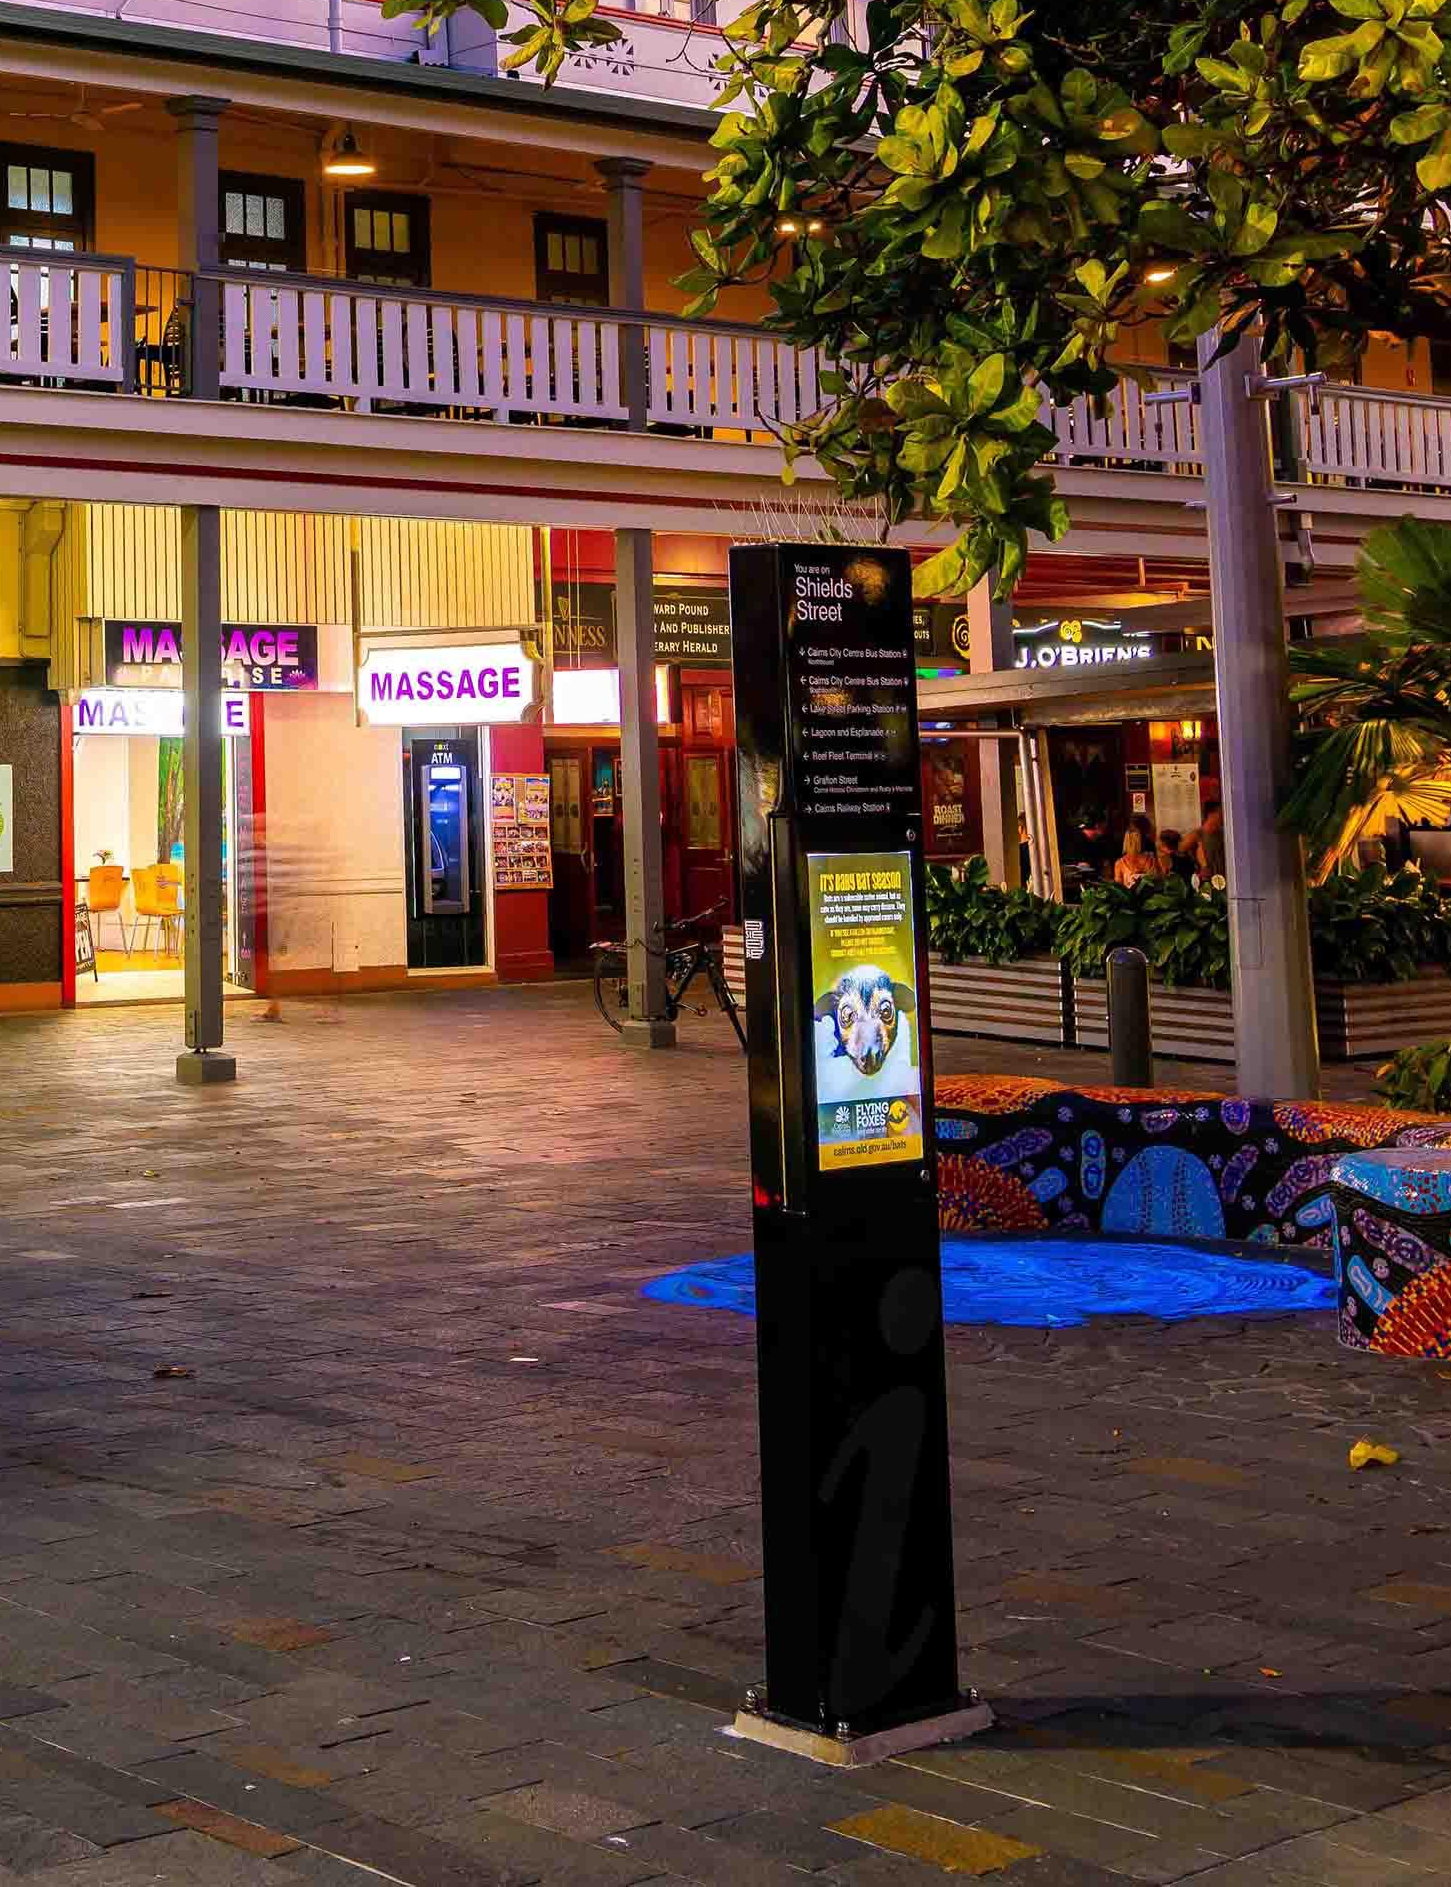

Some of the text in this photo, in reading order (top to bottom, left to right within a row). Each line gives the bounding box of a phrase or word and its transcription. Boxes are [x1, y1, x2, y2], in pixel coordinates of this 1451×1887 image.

[794, 564, 830, 574] You are on
[795, 576, 853, 599] Shields
[679, 604, 709, 616] POUND
[796, 600, 843, 622] Street
[660, 622, 678, 633] AND
[123, 626, 299, 665] MAAGE
[683, 641, 718, 653] HERALD
[807, 648, 901, 659] Cairns City Centre Bus Station
[371, 666, 520, 701] MASSAGE
[808, 676, 829, 685] Cairns
[830, 676, 843, 686] City
[872, 705, 894, 713] Station
[811, 728, 883, 738] Lagoon and Esplanade
[431, 752, 453, 764] ATM
[812, 751, 827, 760] Reef
[813, 776, 858, 785] Grafton Street
[814, 803, 884, 814] Cairns Railway Station
[934, 804, 963, 816] ROAST
[933, 813, 965, 825] DINNER
[856, 1102, 889, 1117] FLYING
[857, 1114, 886, 1128] FOXES
